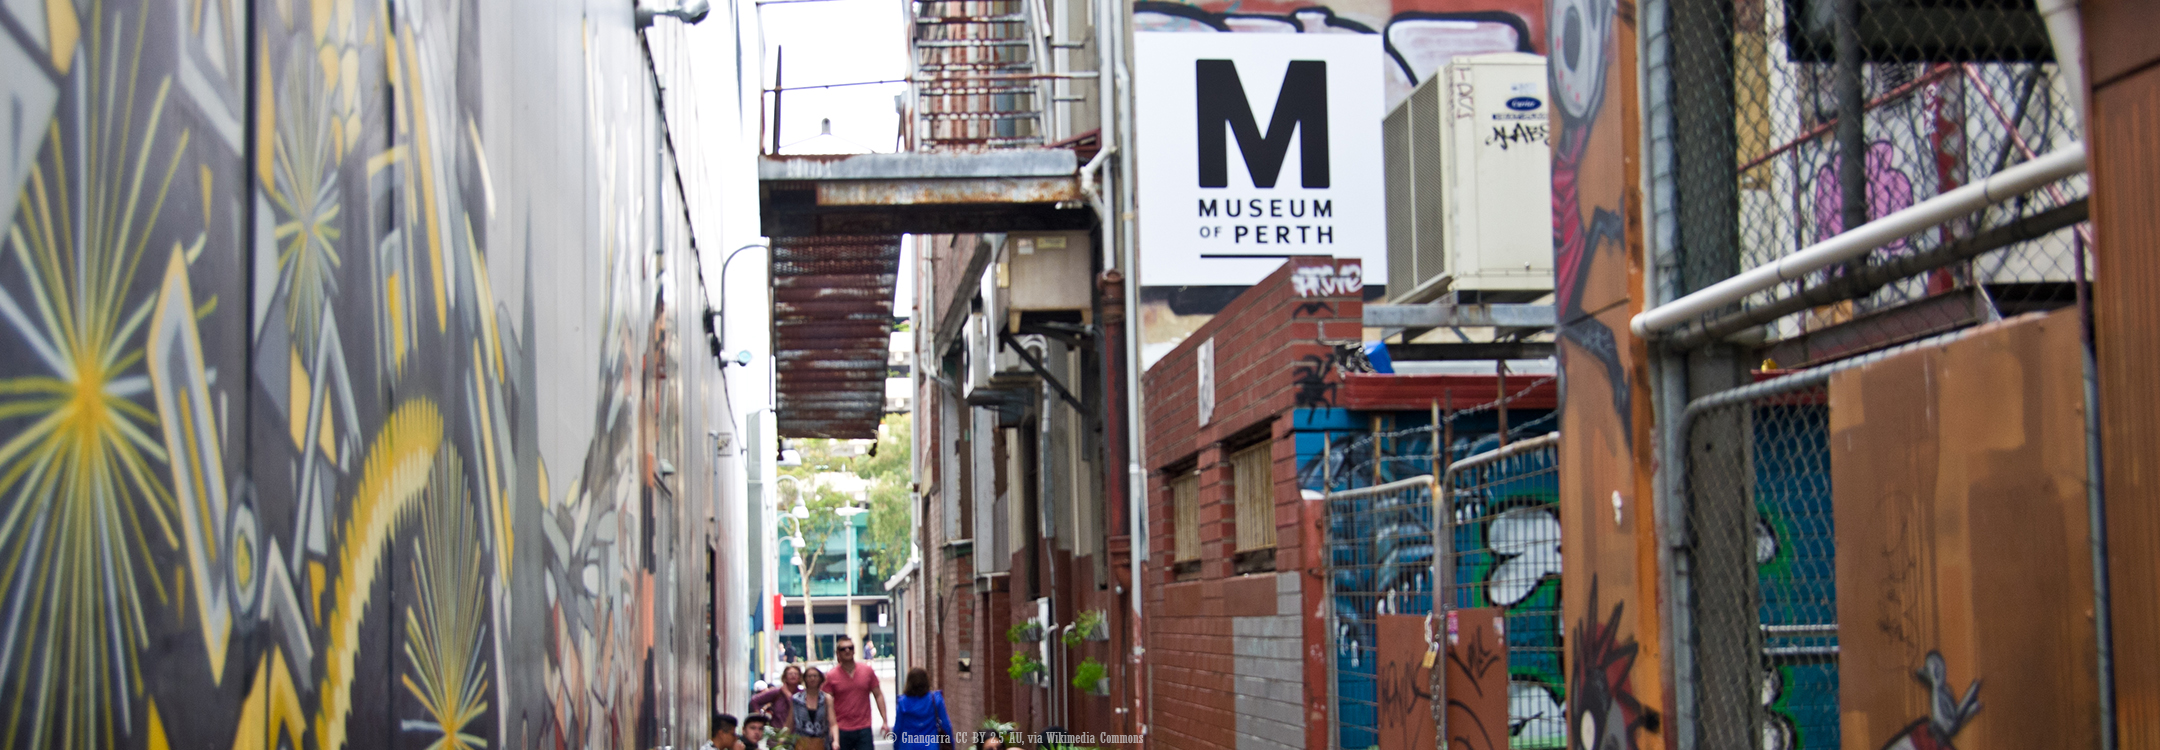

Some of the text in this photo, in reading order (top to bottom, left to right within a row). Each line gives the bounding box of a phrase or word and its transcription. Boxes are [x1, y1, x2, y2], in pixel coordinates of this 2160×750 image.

[1195, 59, 1330, 188] M
[1199, 199, 1333, 218] MUSEUM
[1199, 226, 1334, 245] OF PERTH
